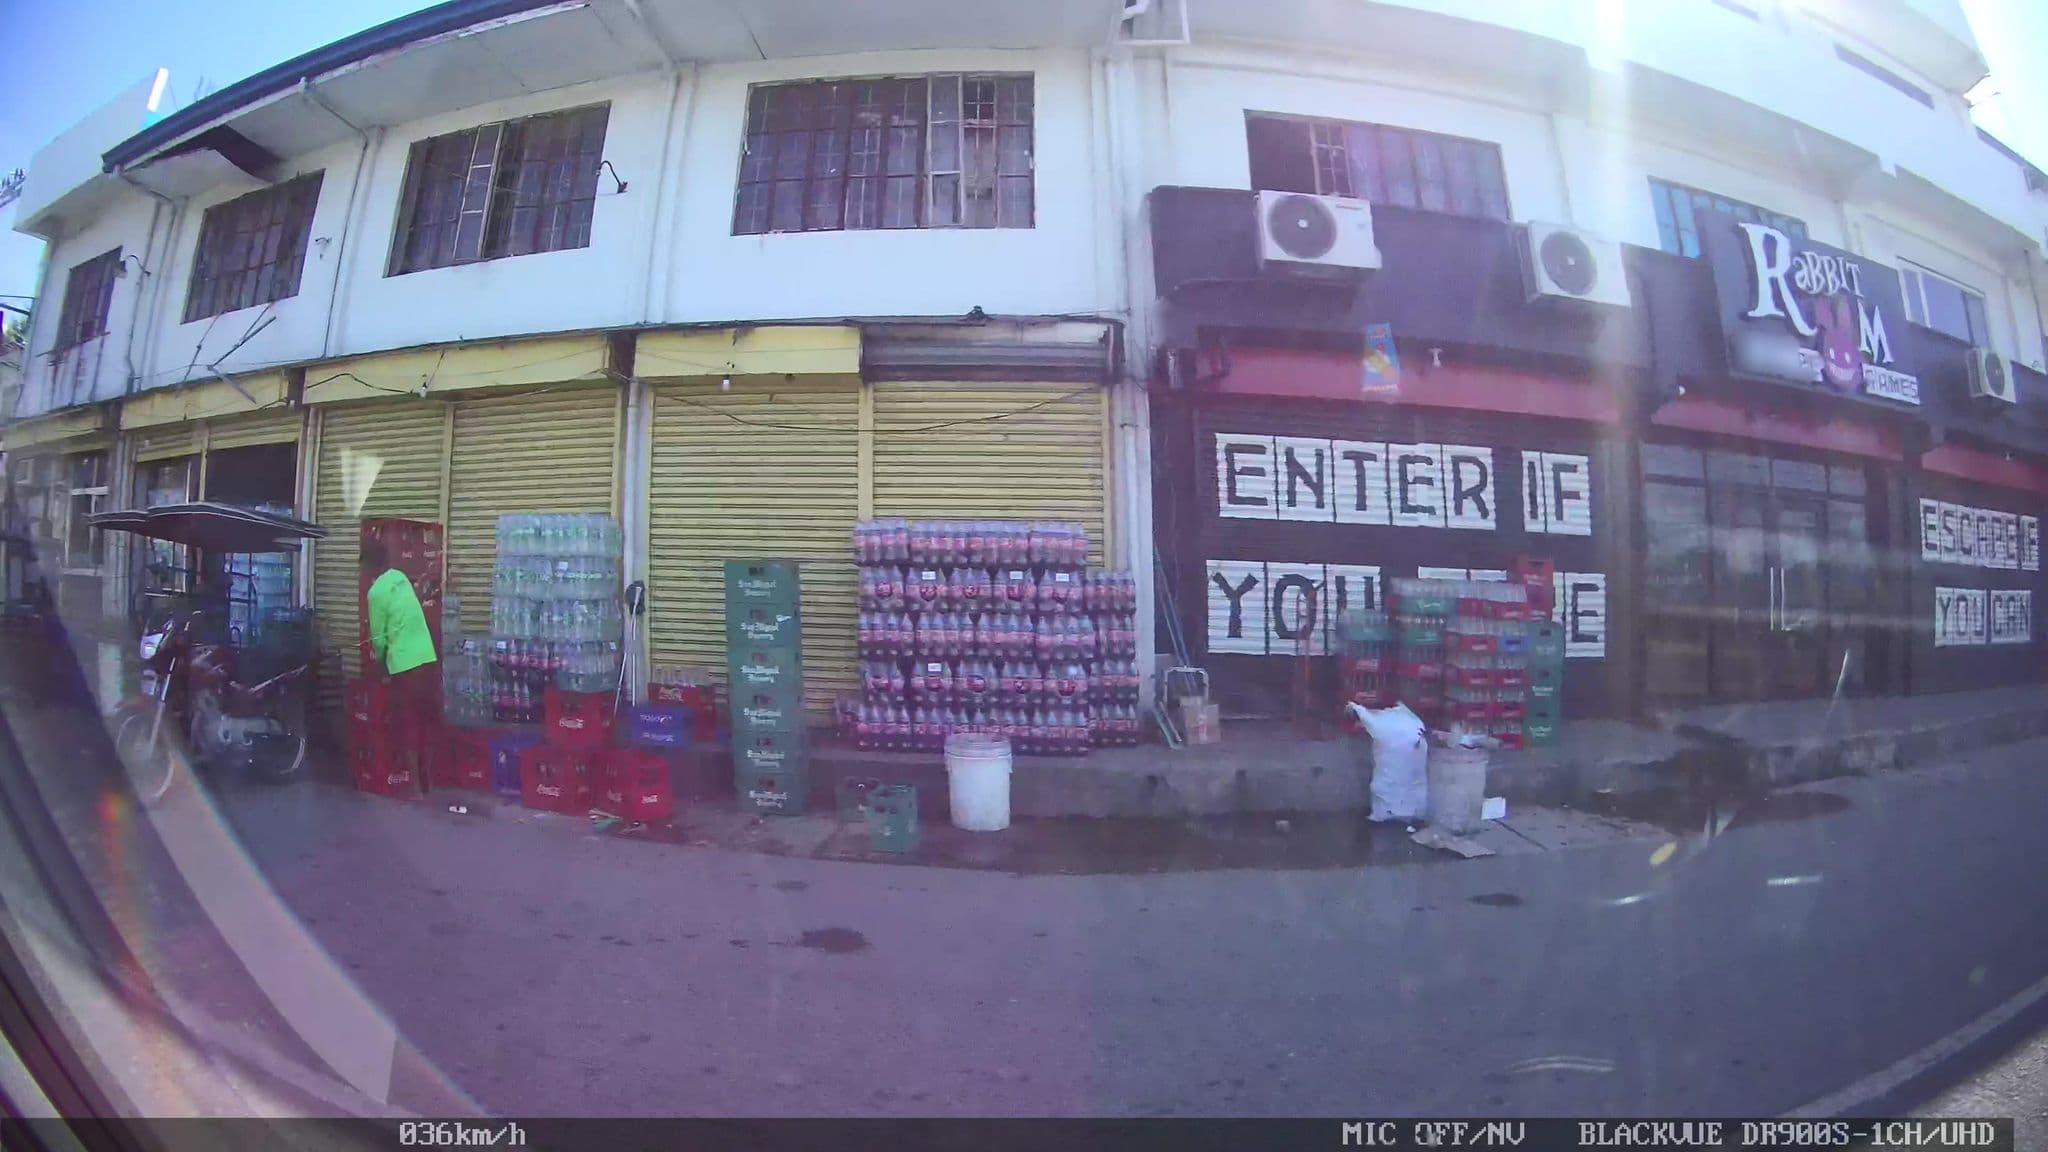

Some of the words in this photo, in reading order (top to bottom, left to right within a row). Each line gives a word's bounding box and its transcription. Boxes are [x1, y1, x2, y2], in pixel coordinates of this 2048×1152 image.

[1224, 442, 1489, 520] ENTER
[1526, 460, 1582, 521] IF
[1923, 505, 2017, 560] ESCAPE
[1938, 594, 1985, 636] YOU
[1993, 594, 2027, 634] CAN
